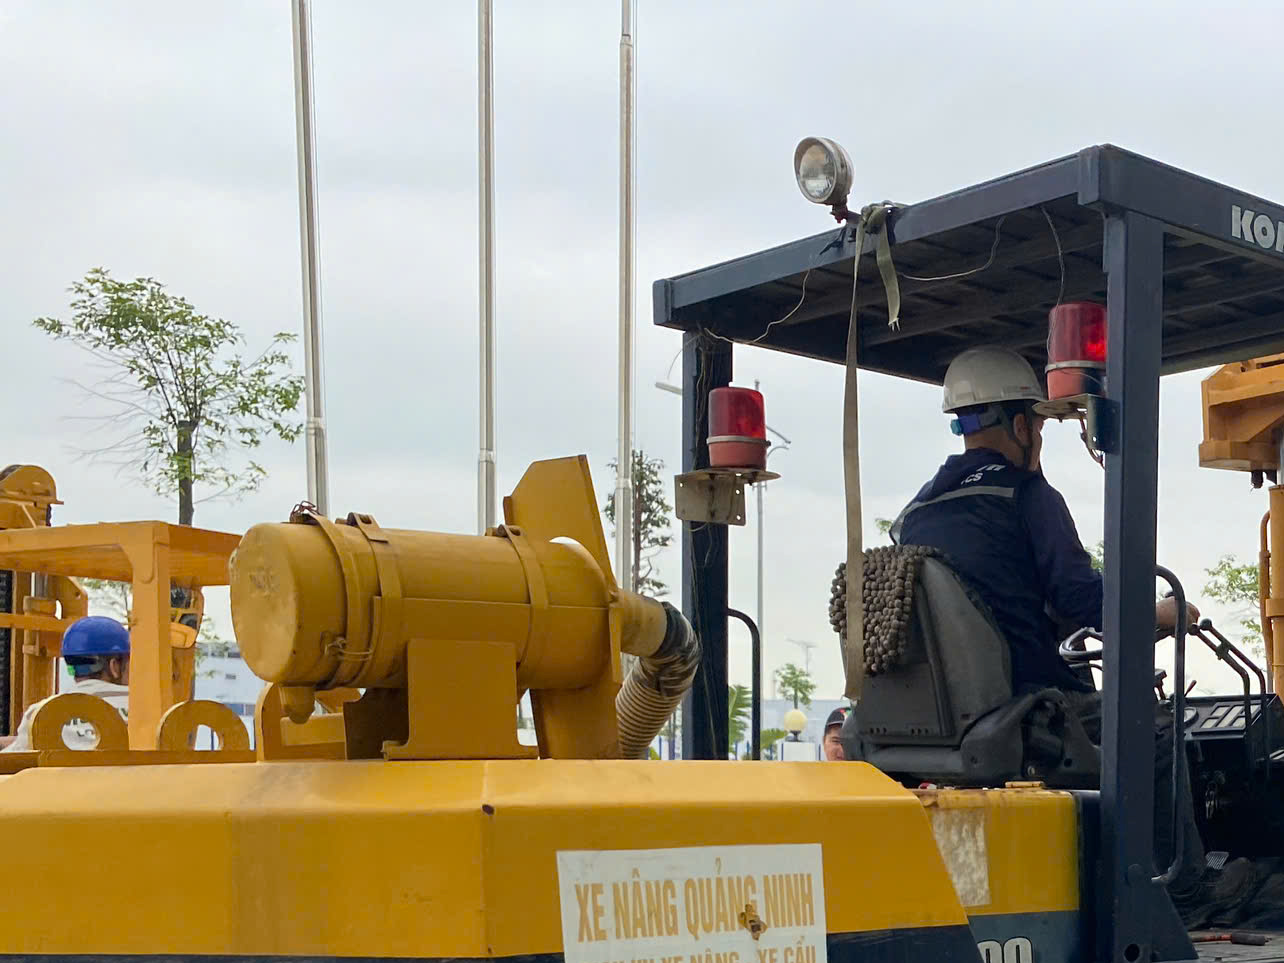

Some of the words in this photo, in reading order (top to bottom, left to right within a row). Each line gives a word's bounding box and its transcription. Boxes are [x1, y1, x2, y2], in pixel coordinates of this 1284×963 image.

[575, 883, 609, 943] XE
[612, 867, 679, 939] NÂNG
[684, 856, 760, 941] QUẢNG
[762, 873, 815, 928] NINH
